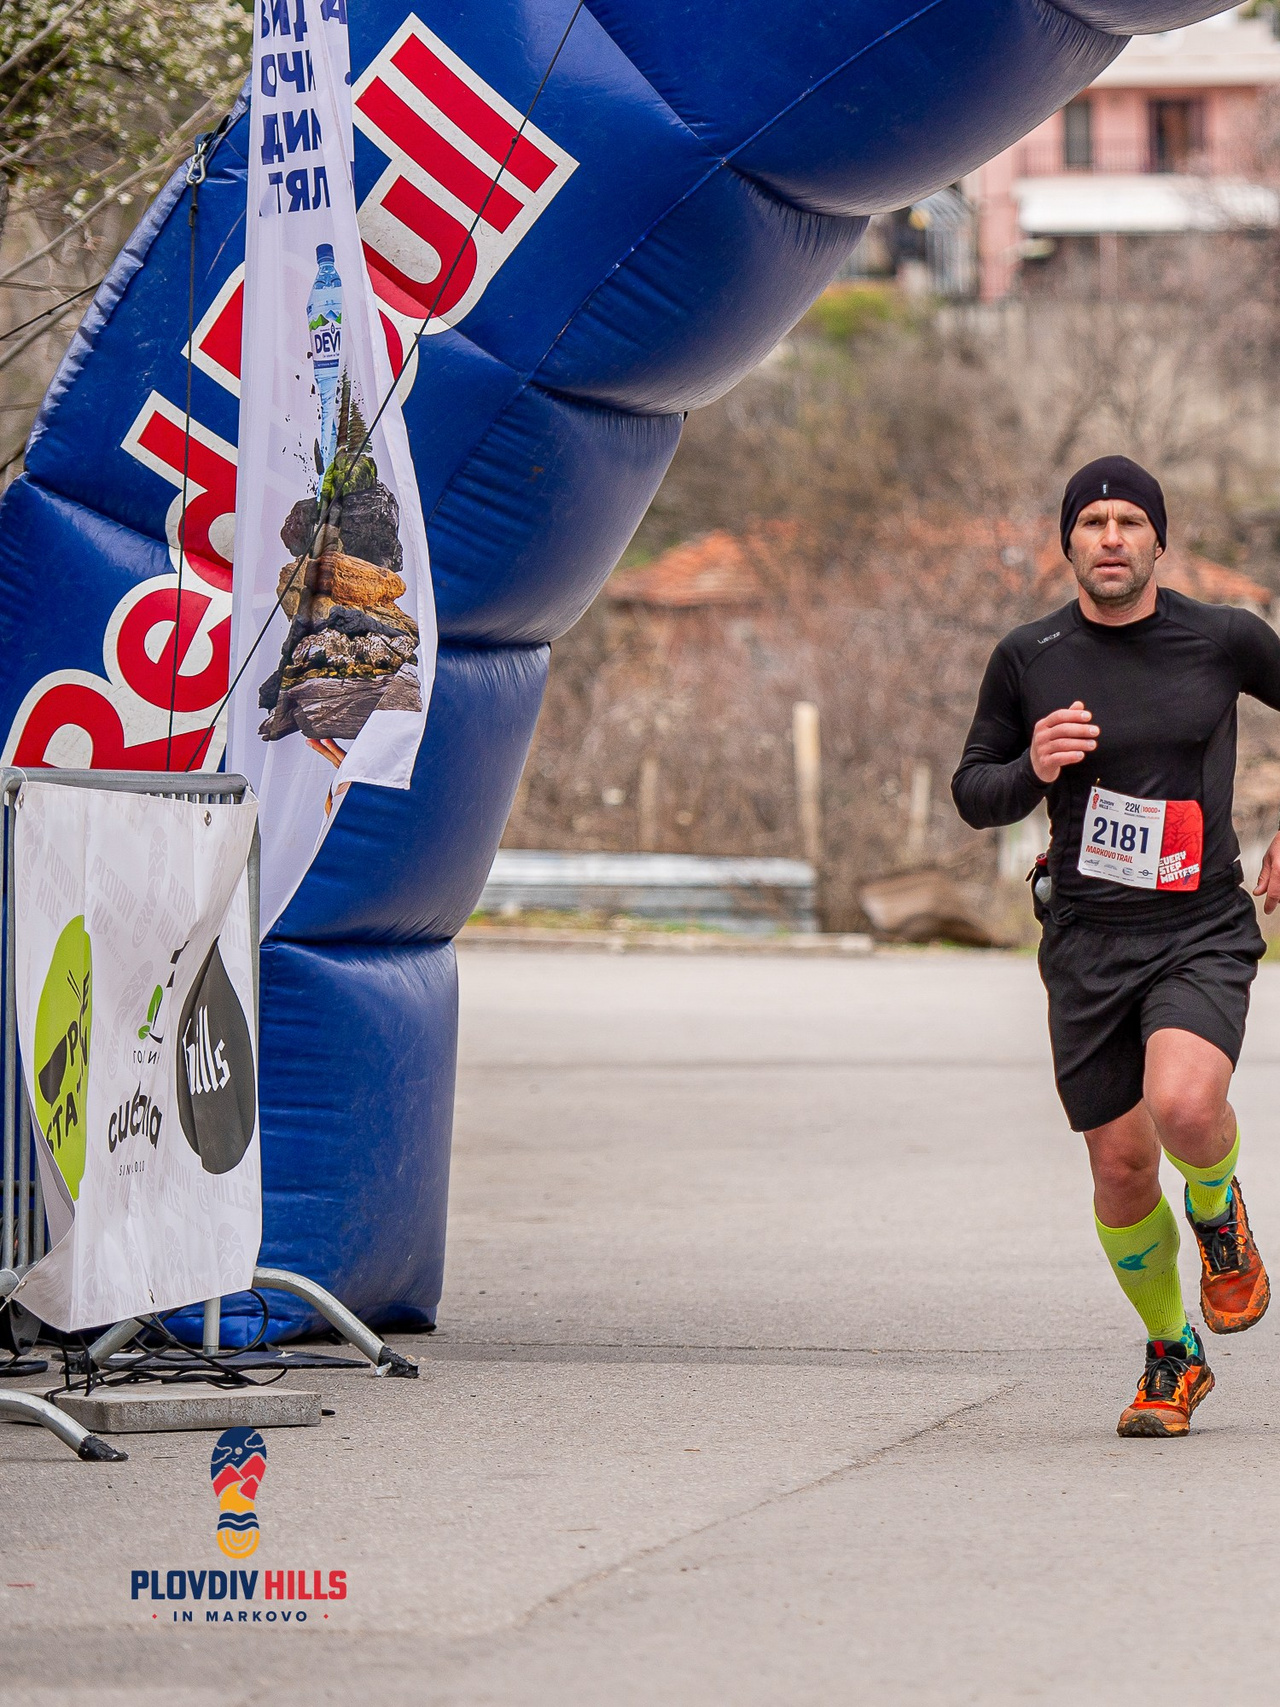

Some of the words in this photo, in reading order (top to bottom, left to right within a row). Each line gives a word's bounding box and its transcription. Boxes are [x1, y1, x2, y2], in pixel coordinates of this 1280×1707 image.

[1125, 802, 1140, 814] 22K
[1091, 816, 1150, 854] 2181
[1085, 845, 1116, 860] MARKOVO
[1116, 853, 1133, 864] TRAIL
[1159, 861, 1182, 875] STEP
[1160, 863, 1200, 884] MATTERS
[182, 1005, 231, 1096] hills
